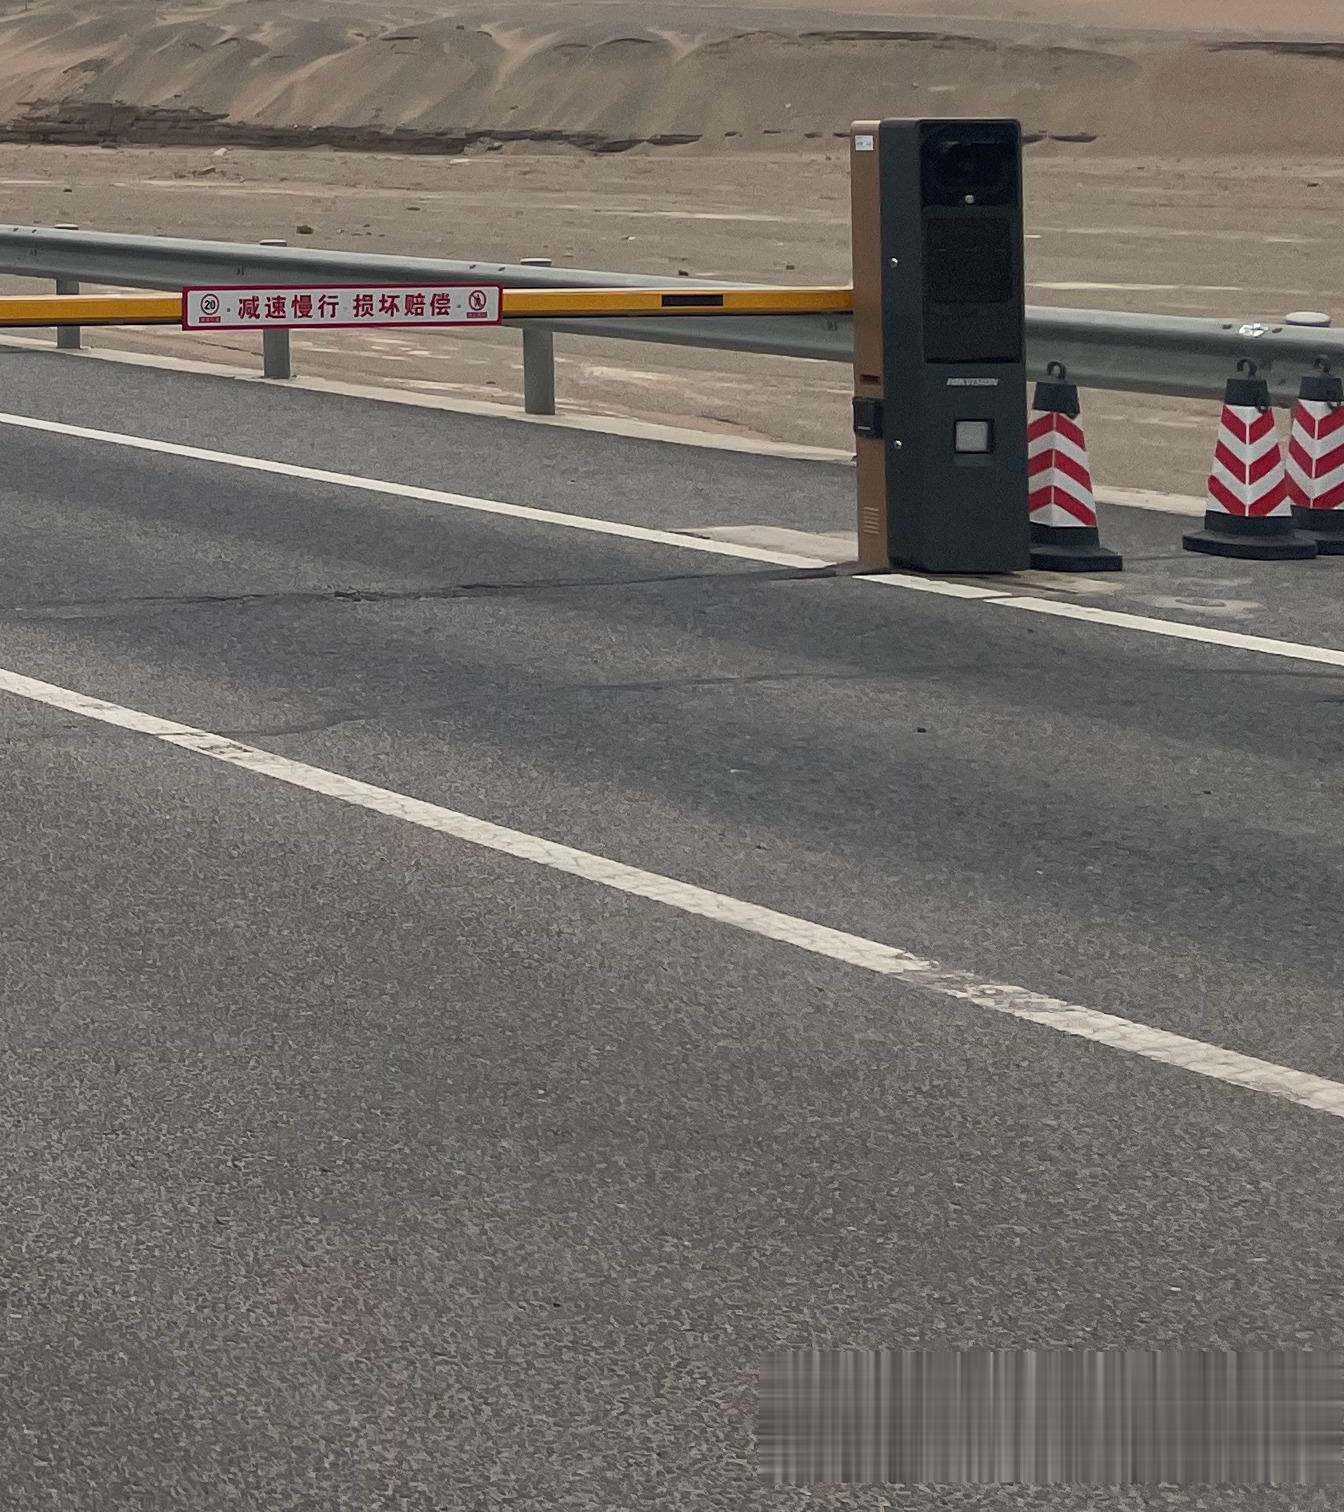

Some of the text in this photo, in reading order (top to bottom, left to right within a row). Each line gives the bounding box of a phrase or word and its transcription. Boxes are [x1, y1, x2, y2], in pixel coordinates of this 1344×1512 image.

[204, 299, 216, 310] 20
[238, 292, 451, 319] 减速慢行 损坏赔偿
